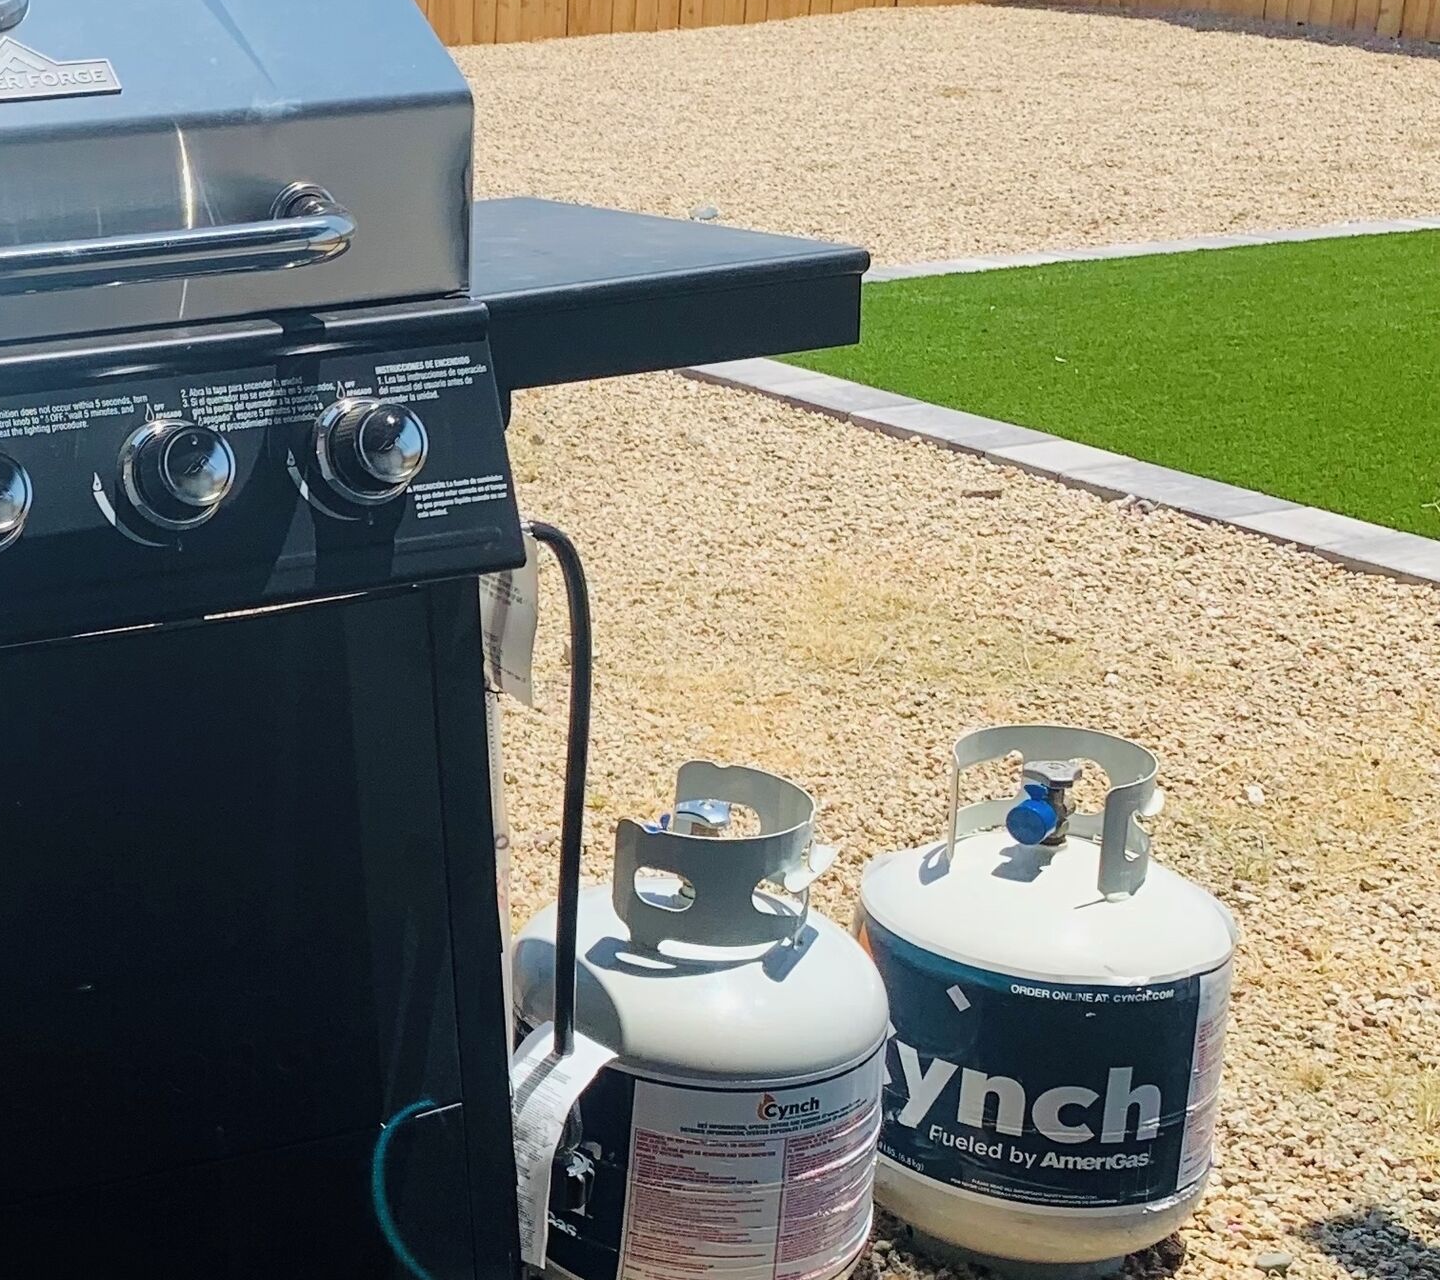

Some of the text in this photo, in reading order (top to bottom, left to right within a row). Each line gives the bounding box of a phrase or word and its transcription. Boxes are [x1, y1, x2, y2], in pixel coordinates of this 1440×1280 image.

[25, 71, 107, 89] FORGE
[12, 418, 30, 426] knob
[83, 410, 89, 418] 5
[121, 405, 134, 414] and
[20, 408, 37, 416] does
[39, 406, 50, 414] not
[51, 404, 71, 413] occur
[72, 402, 94, 410] within
[94, 399, 100, 408] 5
[101, 396, 132, 407] seconds,
[11, 428, 23, 436] the
[24, 425, 50, 436] lighting
[51, 421, 89, 432] procedure.
[1010, 984, 1050, 999] ORDER
[1051, 991, 1093, 1003] ONLINE
[882, 1022, 1161, 1143] ynch
[764, 1097, 820, 1120] Cynch
[928, 1124, 1149, 1171] Fueled by AmeriGas
